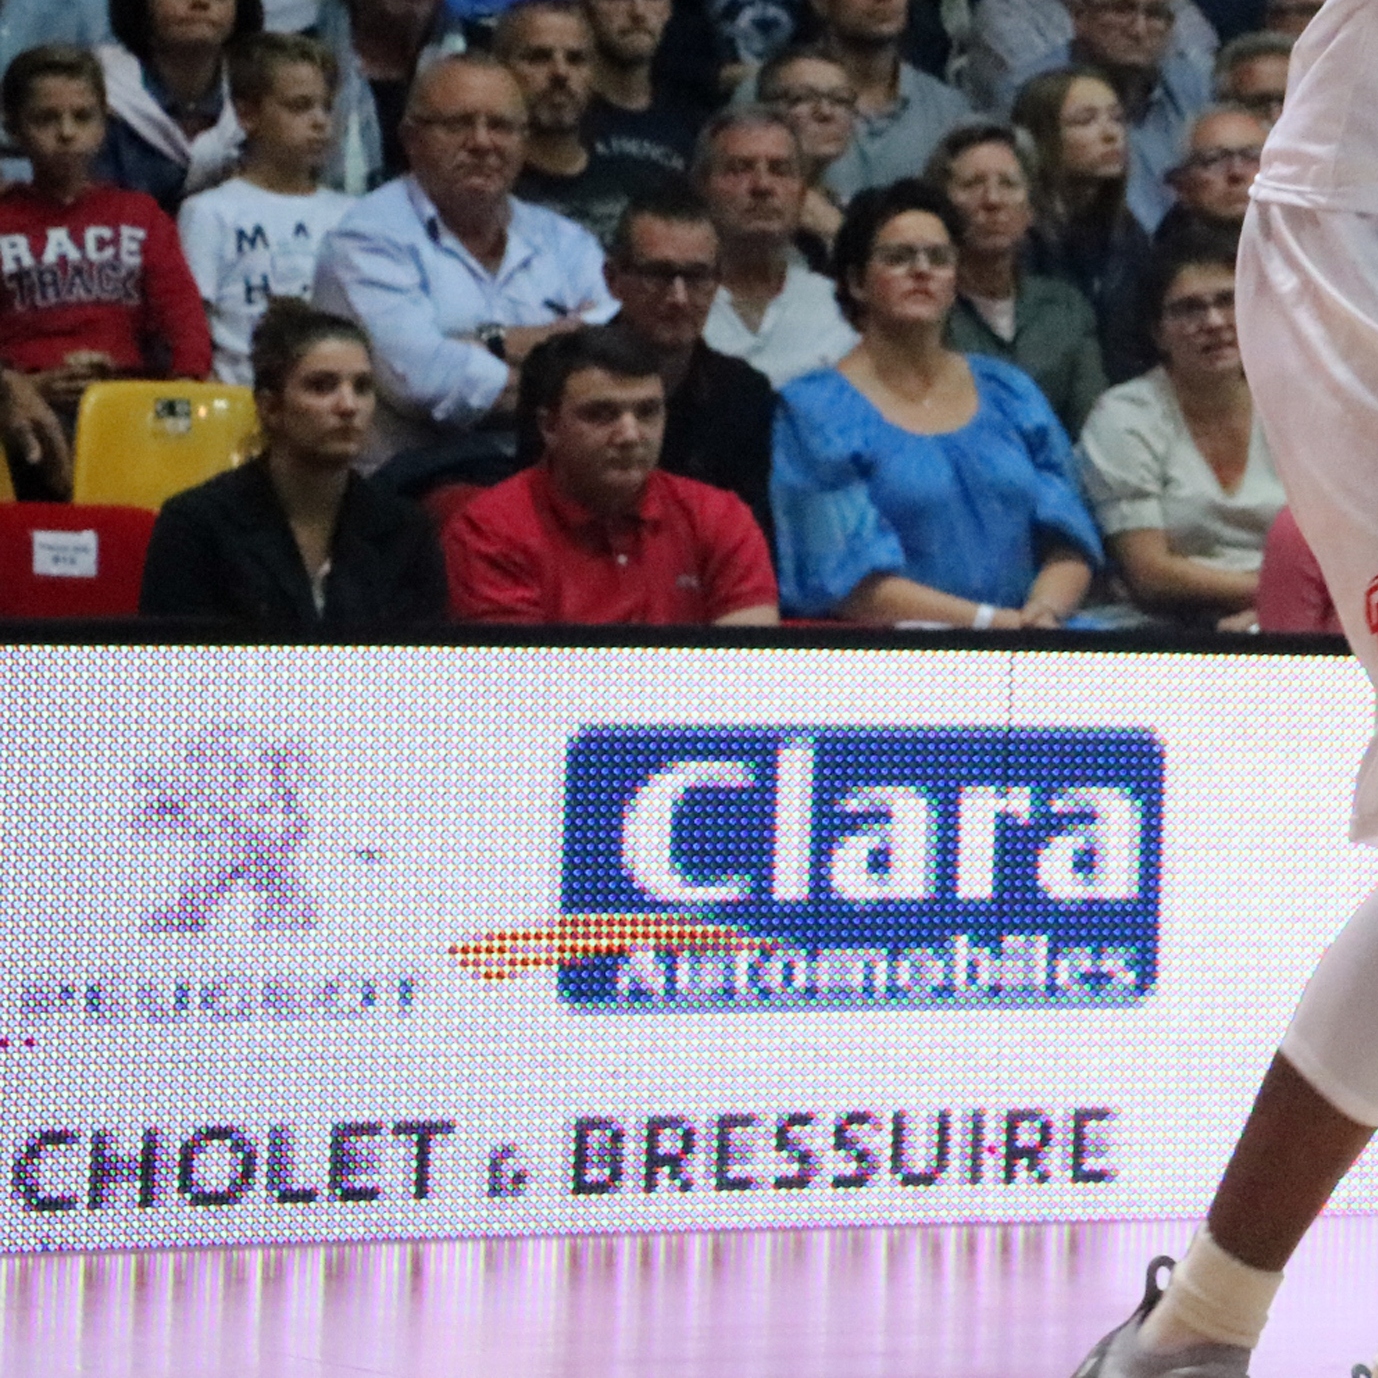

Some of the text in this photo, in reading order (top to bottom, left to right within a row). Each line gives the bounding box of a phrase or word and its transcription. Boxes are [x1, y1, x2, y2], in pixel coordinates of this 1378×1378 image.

[621, 738, 1143, 905] Clara
[614, 934, 1140, 996] Automobiles
[10, 1119, 454, 1211] CHOLET
[570, 1107, 1119, 1196] BRESSUIRE
